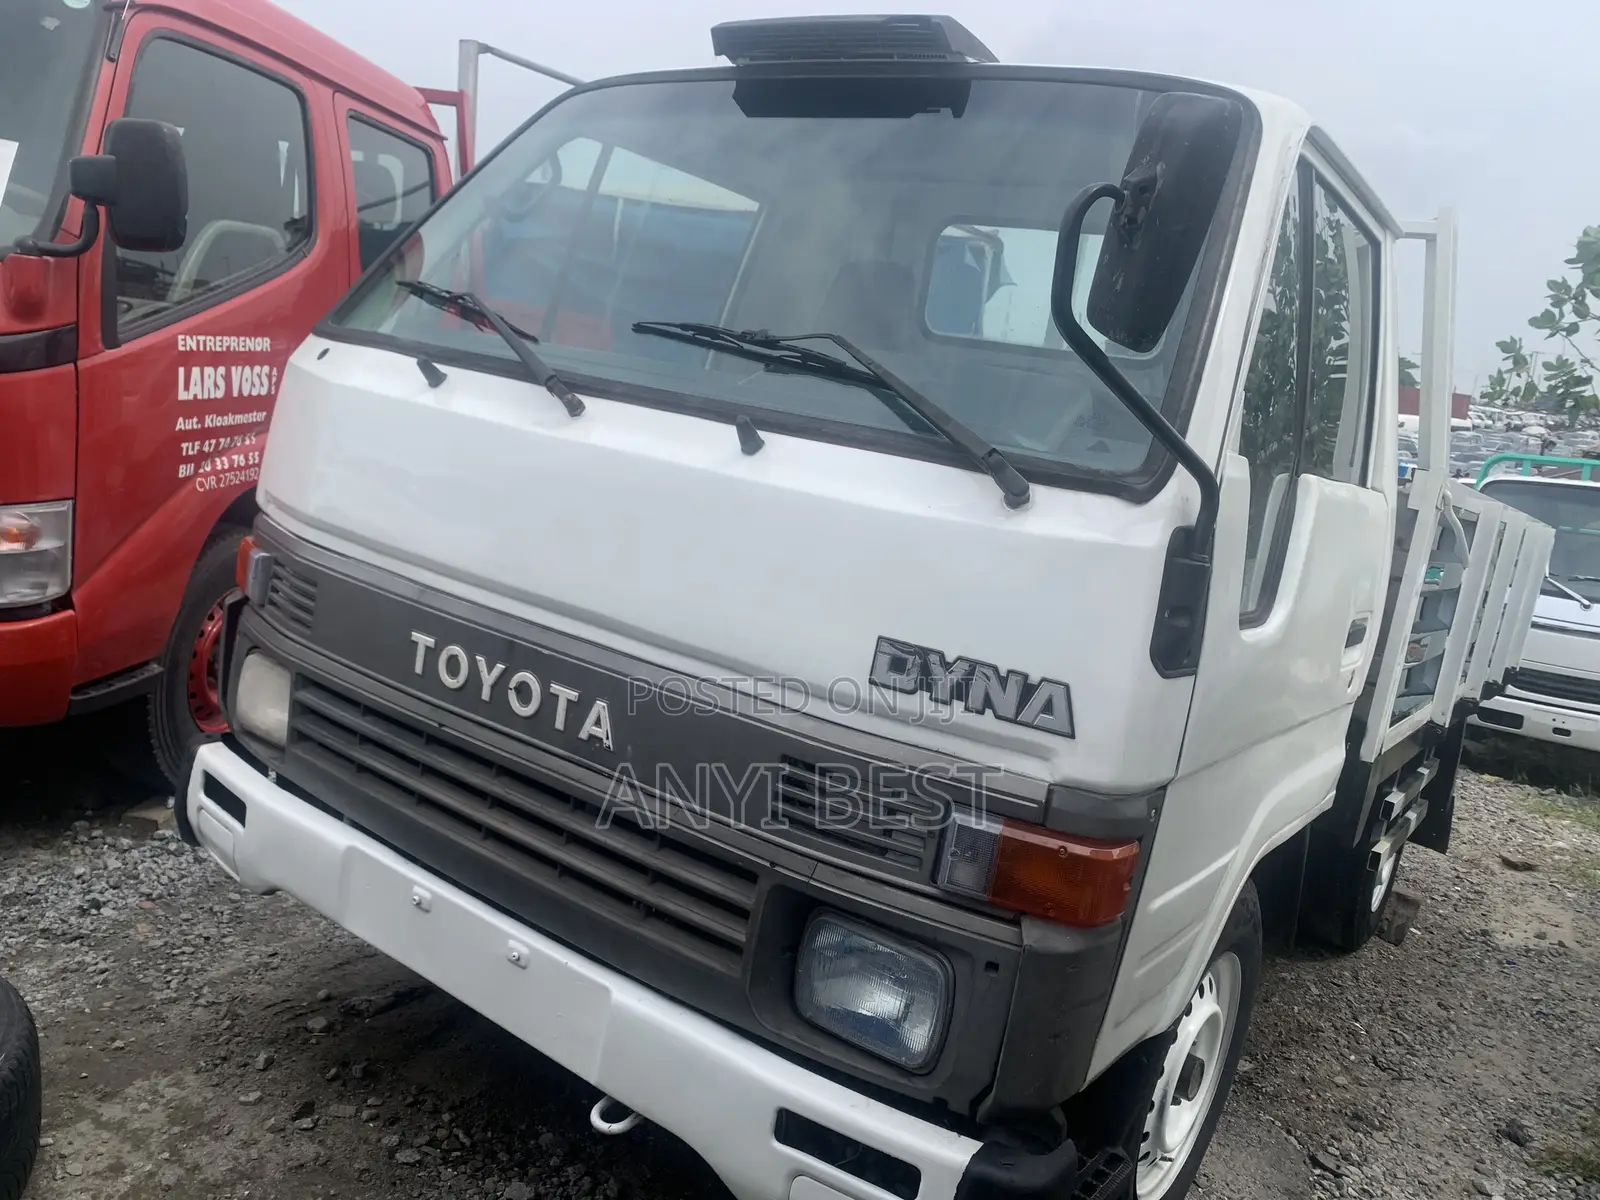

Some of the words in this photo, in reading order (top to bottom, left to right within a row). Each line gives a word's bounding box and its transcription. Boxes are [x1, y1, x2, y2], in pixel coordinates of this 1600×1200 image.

[177, 334, 271, 352] ENTREPRENØR
[177, 366, 226, 401] LARS
[231, 365, 270, 397] VOSS
[175, 416, 202, 431] Aut.
[204, 410, 267, 428] Kloakmester
[180, 441, 201, 456] TLF
[203, 439, 216, 453] 47
[215, 456, 229, 470] 33
[232, 454, 246, 468] 76
[248, 451, 259, 465] 55
[195, 475, 217, 492] CVR
[410, 630, 614, 751] TOYOTA
[867, 635, 1076, 739] DYNA
